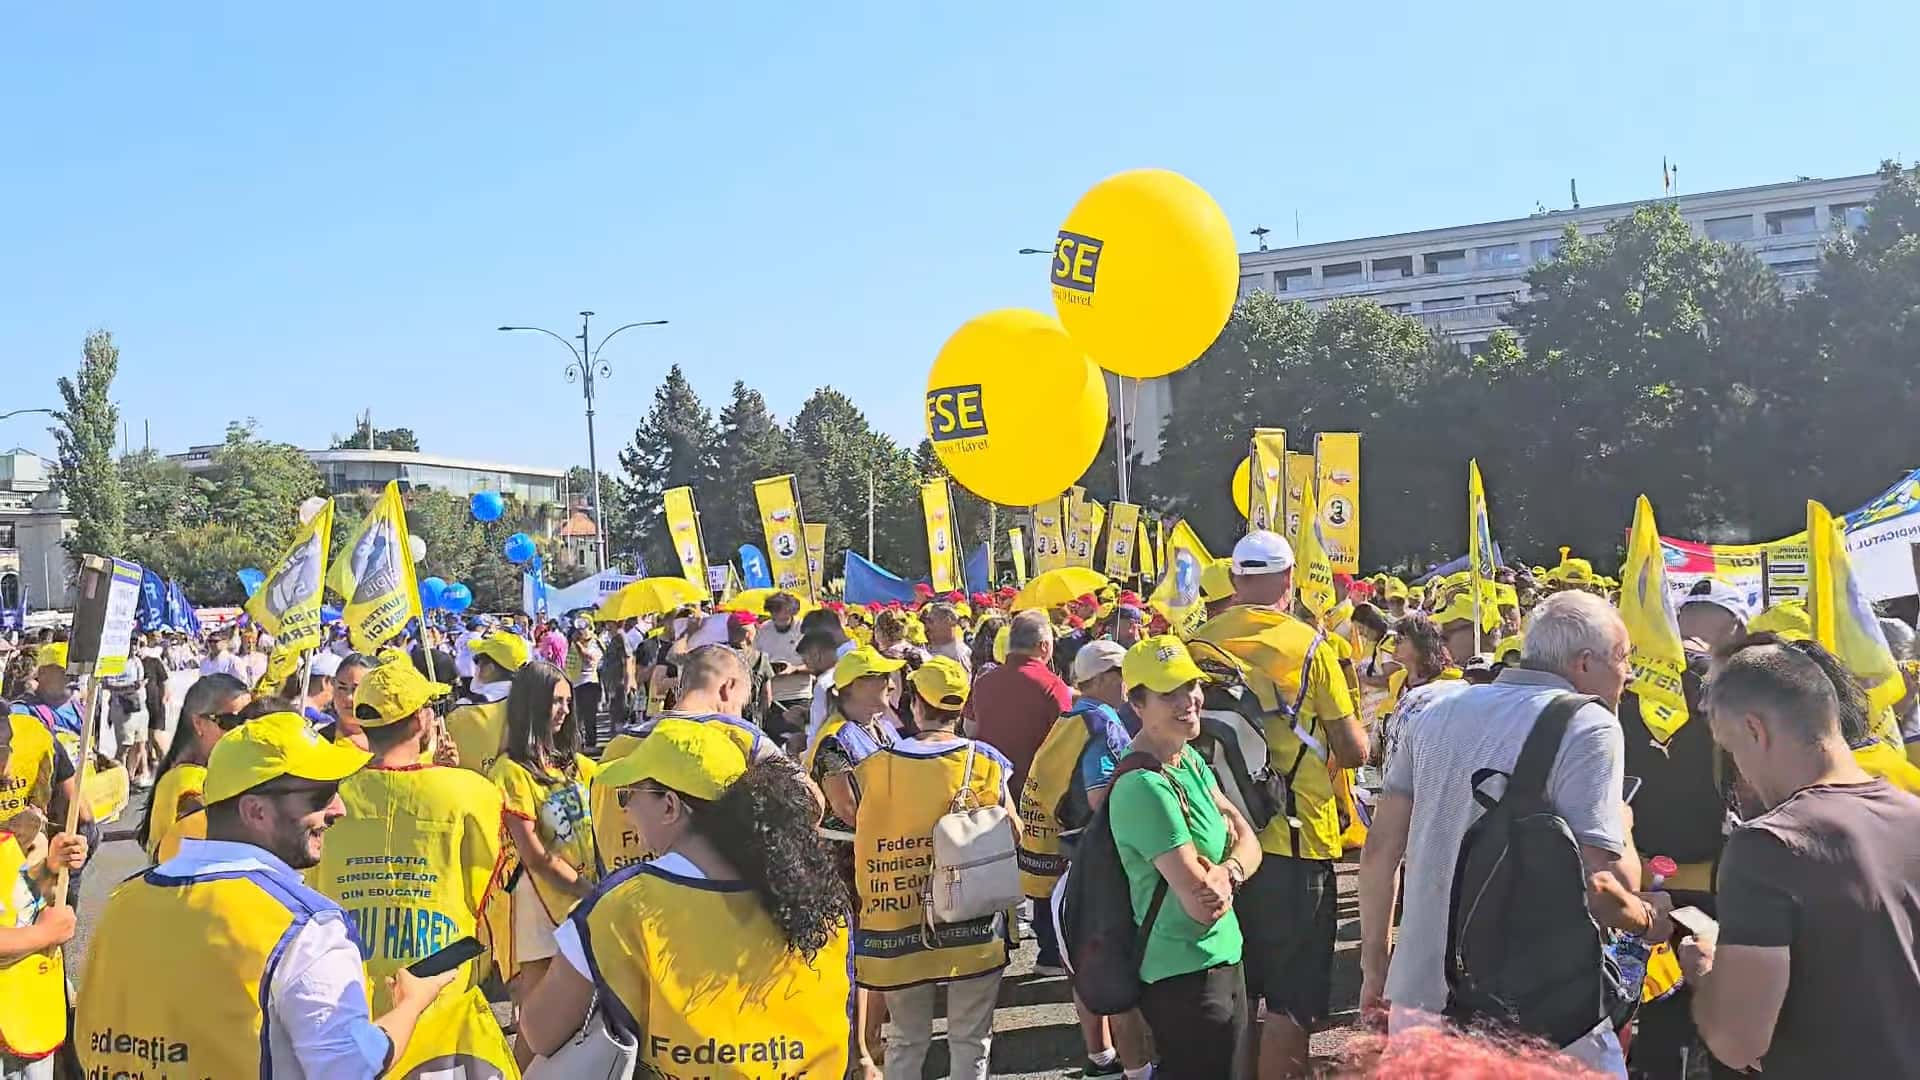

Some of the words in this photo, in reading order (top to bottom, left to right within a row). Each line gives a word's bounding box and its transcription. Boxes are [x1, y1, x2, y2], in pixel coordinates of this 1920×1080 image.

[336, 872, 438, 883] SINDICATELOR
[341, 889, 364, 900] DIN
[650, 1034, 804, 1070] Federația
